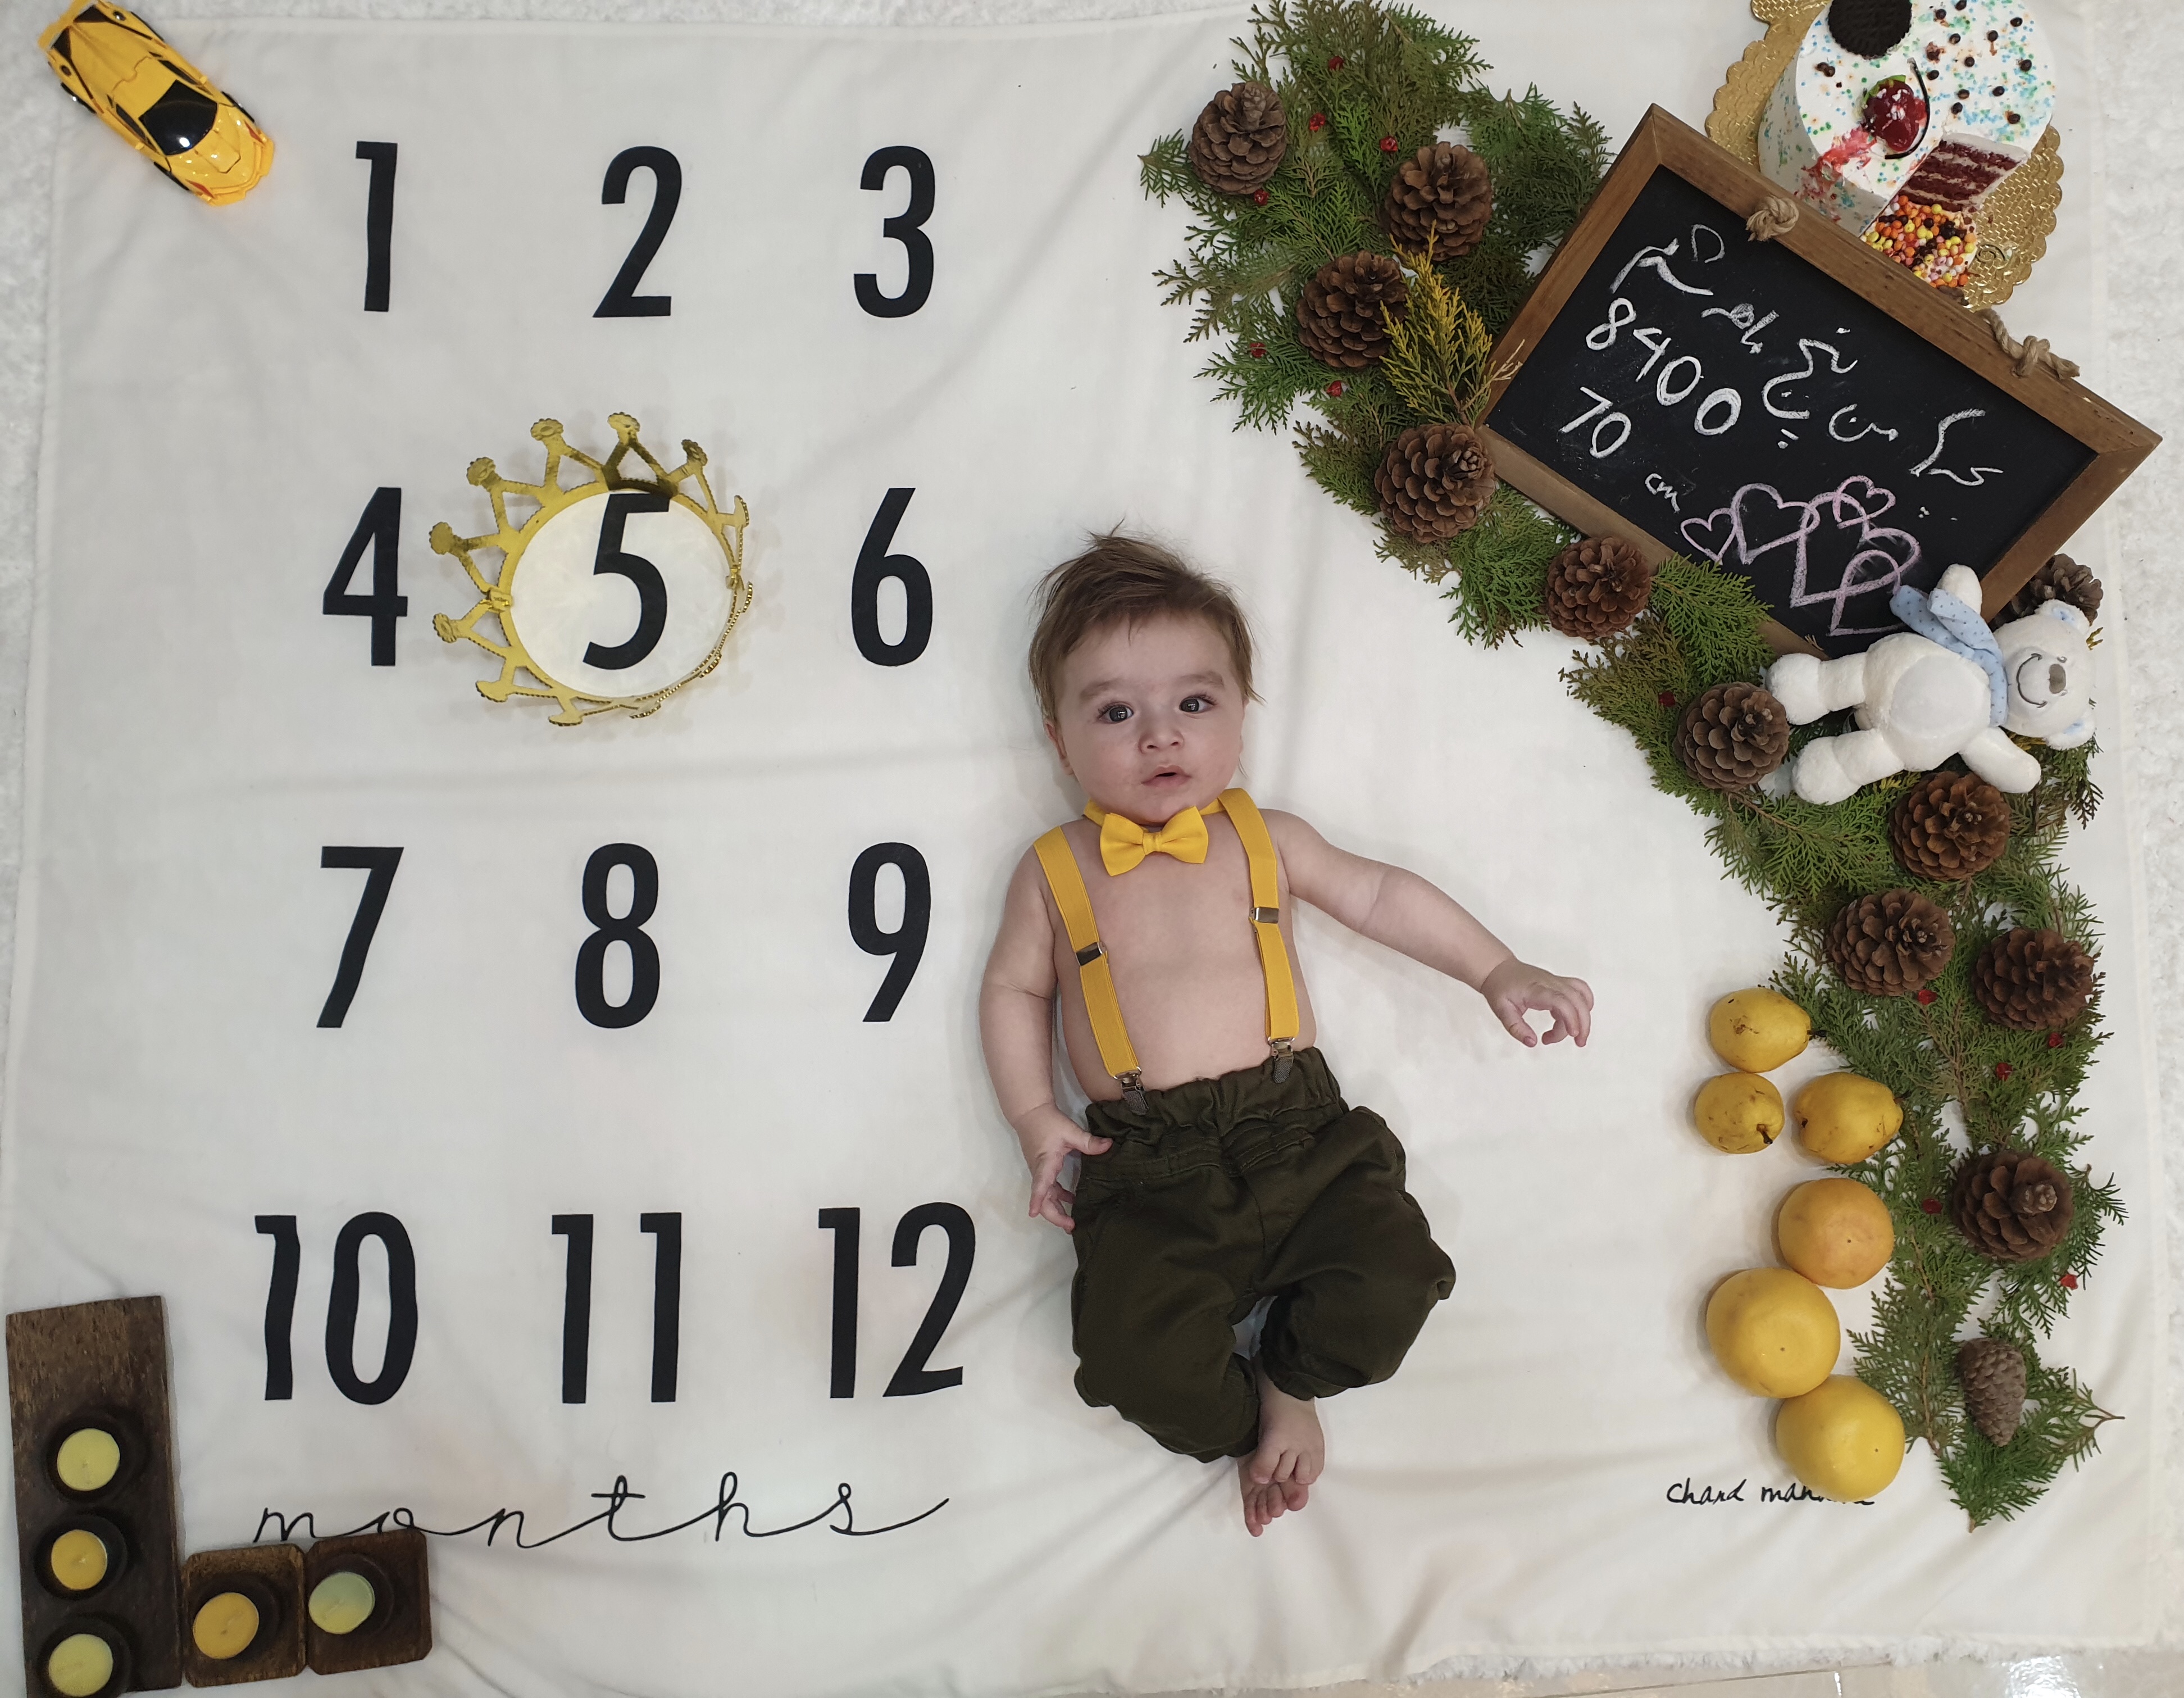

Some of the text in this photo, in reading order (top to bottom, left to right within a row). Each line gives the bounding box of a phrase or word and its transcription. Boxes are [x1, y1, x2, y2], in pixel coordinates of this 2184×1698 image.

[356, 141, 935, 318] 1 2 3
[1559, 387, 1680, 511] 70 cm
[1586, 298, 1741, 435] 8400
[322, 487, 933, 670] 4 5 6
[317, 842, 931, 1029] 7 8 9
[254, 1202, 976, 1405] 10 11 12
[252, 1471, 949, 1549] months
